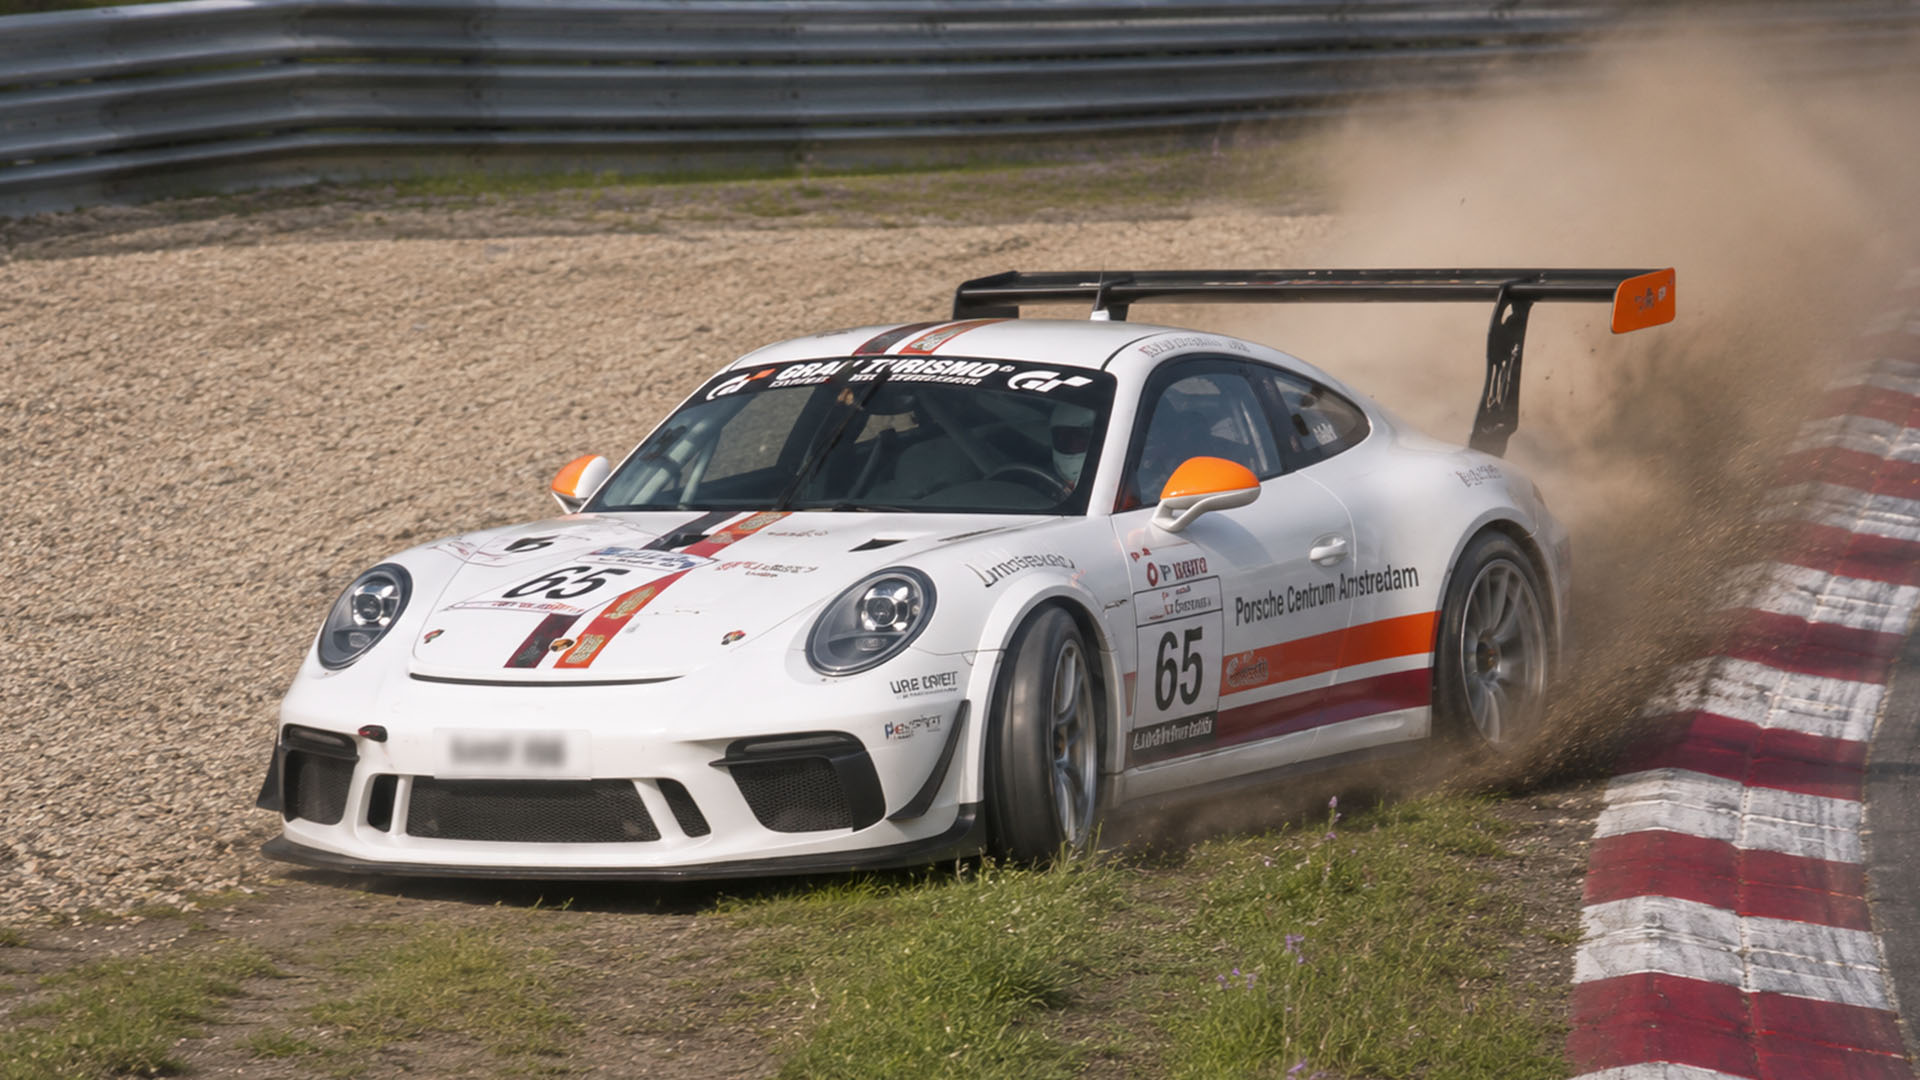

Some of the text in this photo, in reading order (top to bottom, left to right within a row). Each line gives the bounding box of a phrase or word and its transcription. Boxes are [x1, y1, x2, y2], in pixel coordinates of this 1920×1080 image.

[502, 566, 631, 599] 65
[1236, 590, 1284, 626] Porsche
[1287, 582, 1335, 613] Centrum
[1339, 565, 1419, 600] Amstredam
[1155, 626, 1203, 711] 65
